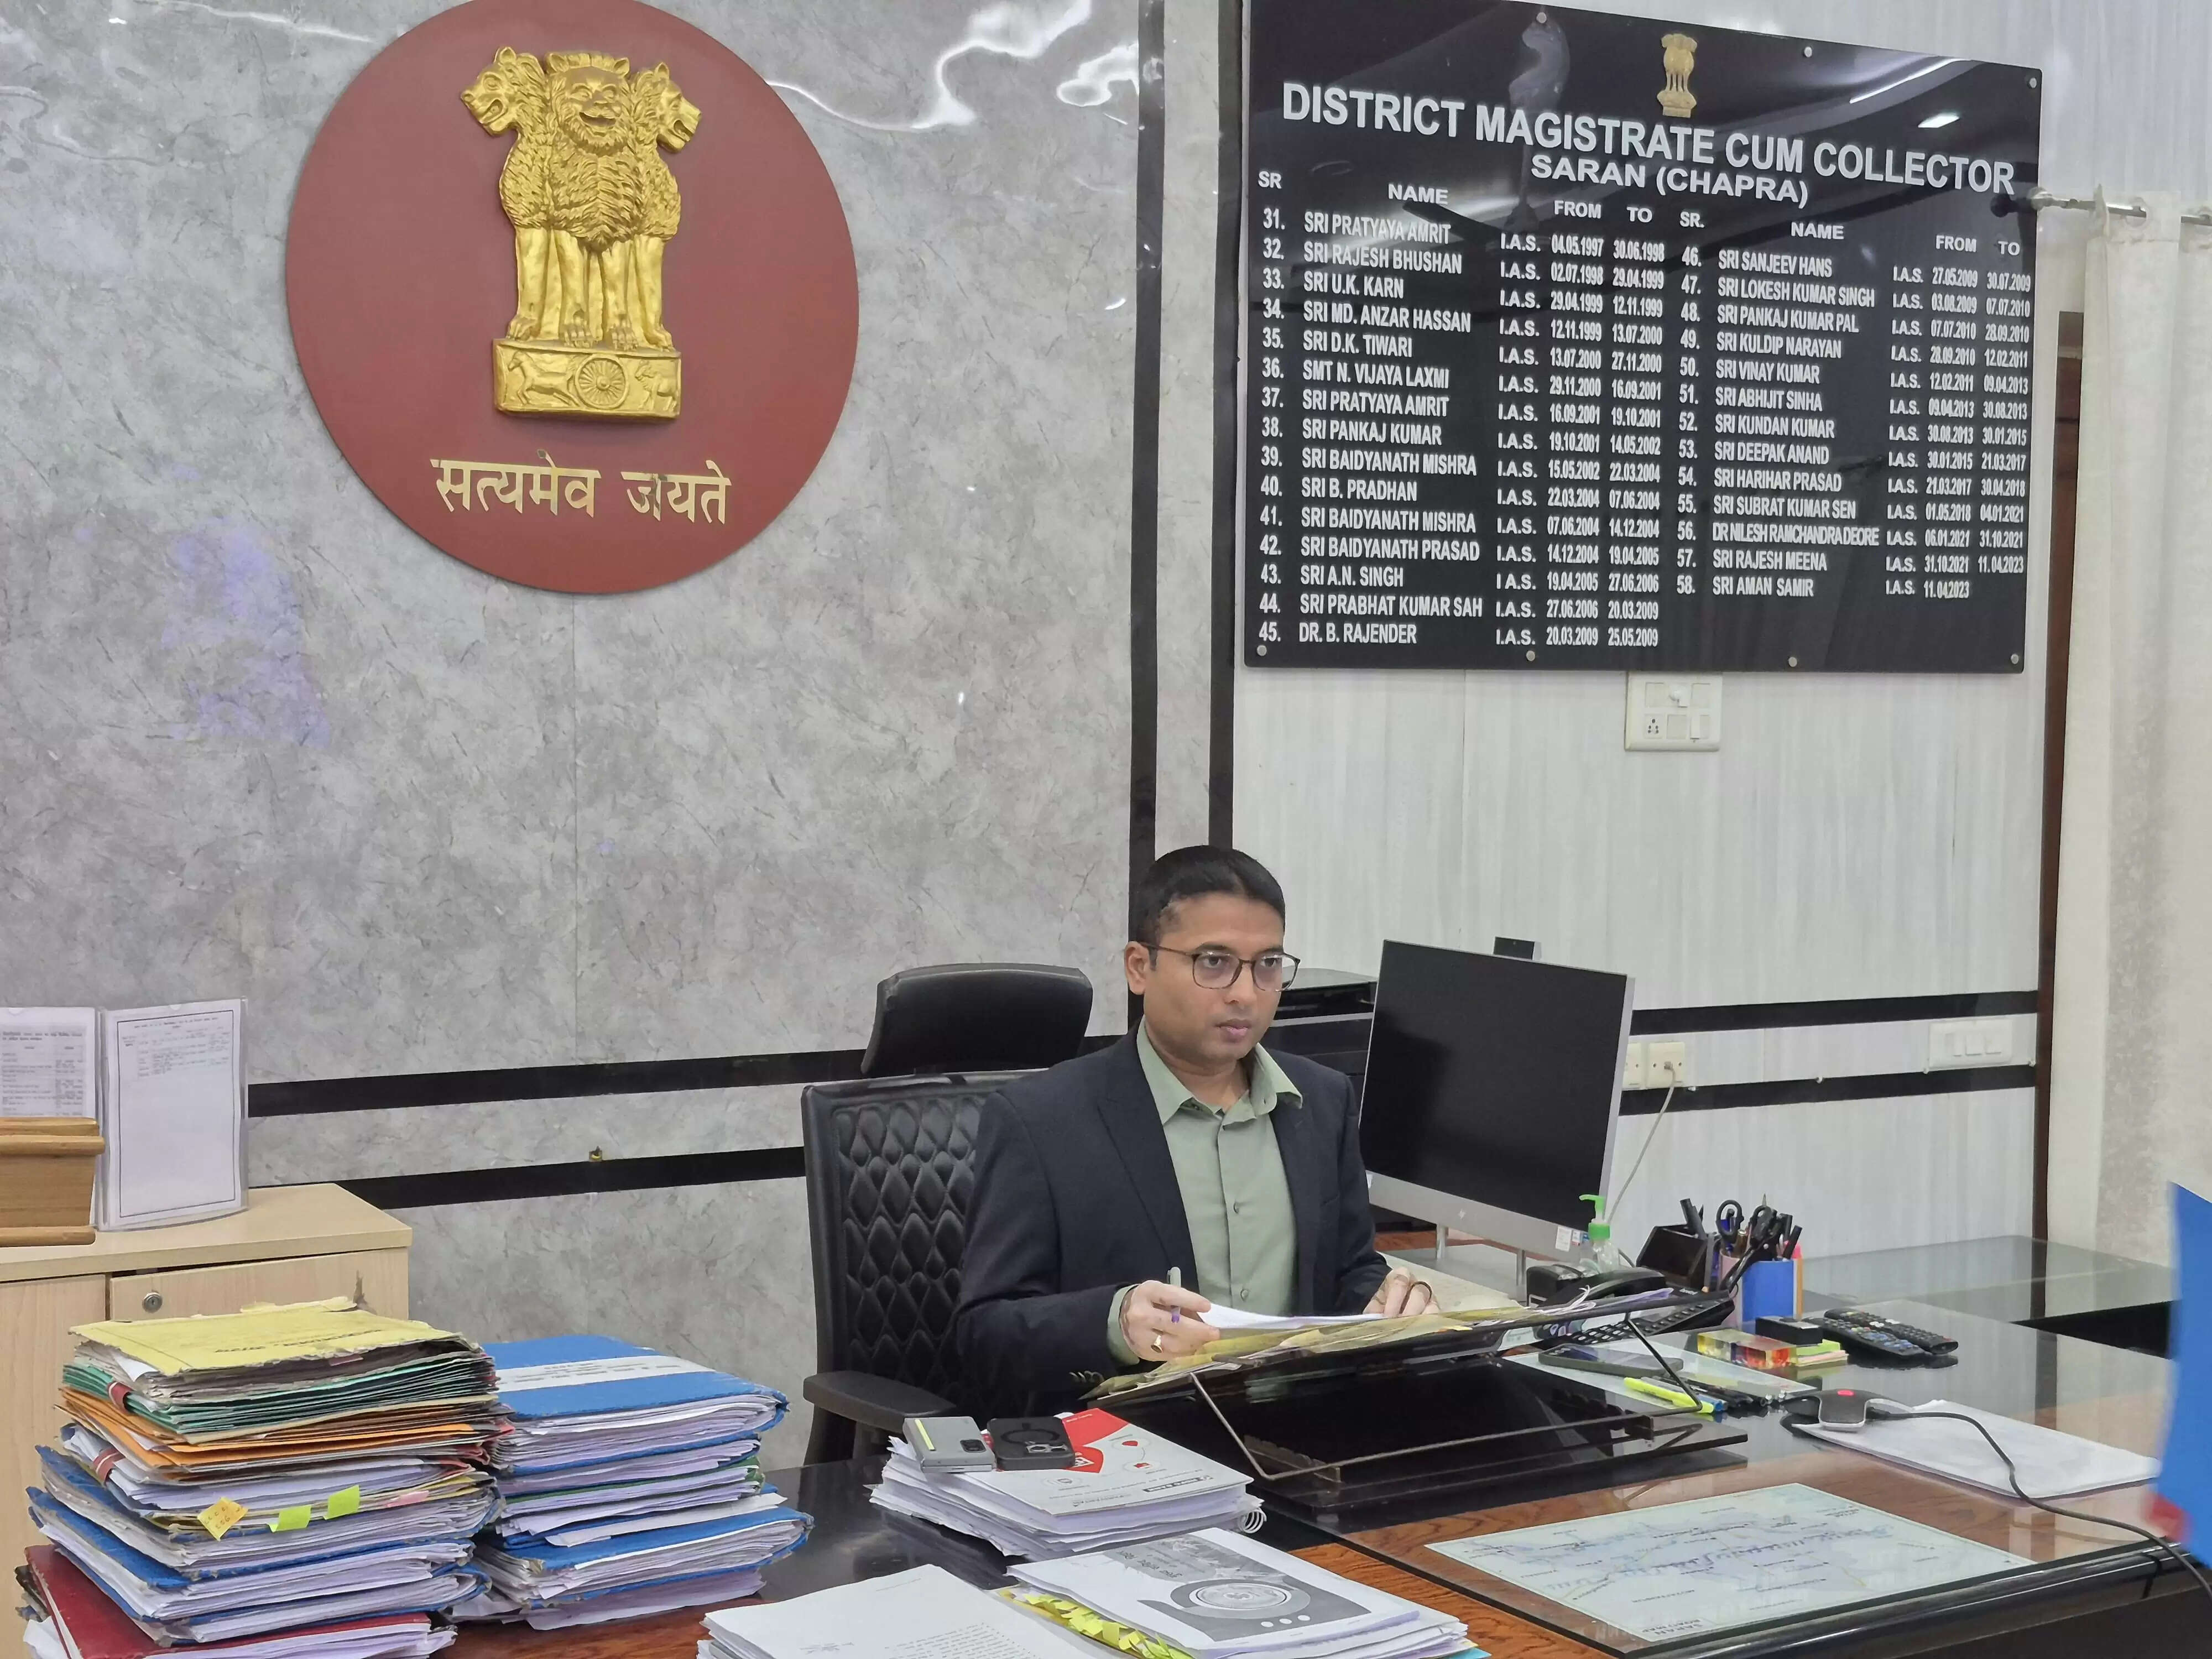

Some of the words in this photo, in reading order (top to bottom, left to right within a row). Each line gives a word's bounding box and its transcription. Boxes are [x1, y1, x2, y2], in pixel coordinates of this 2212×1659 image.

[1284, 82, 1464, 137] DISTRICT
[1476, 105, 1715, 164] MAGISTRATE
[1726, 133, 1803, 173] CUM
[1813, 142, 2015, 195] COLLECTOR
[1258, 170, 1282, 189] SR
[1388, 183, 1448, 205] NAME
[1531, 154, 1646, 188] SARAN
[1656, 167, 1809, 209] (CHAPRA)
[1553, 199, 1602, 219] FROM
[1626, 206, 1653, 223] TO
[1679, 211, 1705, 228] SR.
[1262, 206, 1285, 230] 31.
[1303, 210, 1329, 234] SRI
[1332, 213, 1405, 242] PRATYAYA
[1406, 217, 1452, 244] AMRIT
[1500, 232, 1541, 252] I.A.S.
[1613, 238, 1665, 262] 30.06.1998
[1791, 222, 1844, 240] NAME
[1936, 235, 1978, 253] FROM
[1262, 236, 1284, 260] 32.
[1303, 239, 1332, 263] SRI
[1332, 243, 1389, 268] RAJESH
[1392, 248, 1462, 274] BHUSHAN
[1681, 245, 1702, 267] 46.
[1718, 248, 1739, 269] SRI
[1740, 250, 1798, 275] SANJEEV
[1798, 255, 1833, 278] HANS
[1997, 240, 2021, 257] TO
[1262, 267, 1285, 289] 33.
[1303, 269, 1329, 293] SRI
[1331, 272, 1360, 295] U.K.
[1363, 274, 1404, 299] KARN
[1680, 273, 1702, 295] 47.
[1717, 275, 1739, 298] SRI
[1740, 278, 1790, 301] LOKESH
[1792, 281, 1837, 305] KUMAR
[1838, 285, 1875, 307] SINGH
[1985, 296, 2031, 317] 07.07.2010
[1262, 296, 1285, 319] 34.
[1303, 299, 1328, 322] SRI
[1331, 301, 1358, 325] MD.
[1359, 304, 1410, 328] ANZAR
[1412, 307, 1472, 333] HASSAN
[1680, 301, 1700, 322] 48.
[1717, 303, 1738, 325] SRI
[1739, 304, 1788, 328] PANKAJ
[1790, 309, 1834, 331] KUMAR
[1835, 312, 1859, 333] PAL
[1262, 326, 1284, 349] 35.
[1302, 328, 1328, 352] SRI
[1331, 331, 1360, 354] D.K.
[1361, 333, 1412, 358] TIWARI
[1679, 327, 1700, 349] 49.
[1715, 330, 1737, 352] SRI
[1739, 331, 1784, 355] KULDIP
[1785, 335, 1841, 359] NARAYAN
[1261, 356, 1284, 379] 36.
[1302, 358, 1333, 381] SMT
[1336, 361, 1352, 383] N.
[1354, 362, 1403, 386] VIJAYA
[1405, 364, 1449, 389] LAXMI
[1679, 356, 1699, 377] 50.
[1715, 358, 1737, 379] SRI
[1738, 359, 1775, 382] VINAY
[1776, 362, 1820, 384] KUMAR
[1261, 385, 1284, 408] 37.
[1302, 388, 1327, 410] SRI
[1329, 390, 1403, 415] PRATYAYA
[1404, 393, 1450, 417] AMRIT
[1678, 382, 1699, 405] 51.
[1714, 385, 1736, 406] SRI
[1736, 387, 1785, 410] ABHIJIT
[1785, 389, 1823, 412] SINHA
[1261, 415, 1283, 437] 38.
[1302, 417, 1327, 440] SRI
[1329, 419, 1387, 443] PANKAJ
[1389, 421, 1442, 446] KUMAR
[1678, 410, 1698, 431] 52.
[1714, 412, 1736, 434] SRI
[1737, 414, 1789, 436] KUNDAN
[1791, 416, 1835, 439] KUMAR
[1260, 445, 1283, 467] 39.
[1301, 446, 1327, 468] SRI
[1329, 447, 1420, 473] BAIDYANATH
[1422, 452, 1477, 476] MISHRA
[1678, 438, 1698, 459] 53.
[1714, 440, 1735, 461] SRI
[1736, 441, 1786, 463] DEEPAK
[1786, 443, 1829, 465] ANAND
[430, 449, 602, 518] सत्यमेव
[620, 460, 732, 524] जयते
[1260, 474, 1282, 497] 40.
[1301, 476, 1326, 498] SRI
[1328, 477, 1343, 499] B.
[1346, 478, 1417, 502] PRADHAN
[1496, 487, 1537, 507] I.A.S.
[1677, 465, 1697, 487] 54.
[1713, 466, 1734, 488] SRI
[1736, 468, 1791, 490] HARIHAR
[1792, 471, 1842, 492] PRASAD
[1259, 504, 1282, 526] 41.
[1301, 505, 1326, 528] SRI
[1328, 507, 1419, 531] BAIDYANATH
[1422, 510, 1476, 533] MISHRA
[1677, 493, 1697, 514] 55.
[1713, 494, 1734, 515] SRI
[1735, 495, 1785, 517] SUBRAT
[1786, 497, 1830, 518] KUMAR
[1831, 499, 1856, 519] SEN
[1259, 533, 1282, 555] 42.
[1300, 535, 1326, 557] SRI
[1328, 536, 1418, 560] BAIDYANATH
[1421, 539, 1480, 561] PRASAD
[1676, 519, 1696, 541] 56.
[1712, 521, 1729, 542] DR
[1729, 521, 1768, 542] NILESH
[1842, 525, 1880, 546] DEORE
[1676, 547, 1697, 567] 57.
[1712, 547, 1733, 568] SRI
[1735, 548, 1783, 570] RAJESH
[1785, 550, 1828, 571] MEENA
[1923, 554, 1969, 573] 31.10.2021
[1260, 562, 1281, 585] 43.
[1300, 564, 1324, 585] SRI
[1326, 564, 1356, 586] A.N.
[1359, 565, 1404, 587] SINGH
[1608, 571, 1659, 593] 27.06.2006
[1676, 573, 1695, 594] 58.
[1712, 575, 1734, 595] SRI
[1735, 576, 1772, 596] AMAN
[1776, 577, 1814, 597] SAMIR
[1259, 592, 1281, 613] 44.
[1299, 592, 1324, 614] SRI
[1327, 593, 1396, 615] PRABHAT
[1398, 595, 1451, 617] KUMAR
[1452, 596, 1483, 617] SAH
[1546, 598, 1598, 619] 27.06.2006
[1607, 599, 1659, 620] 20.03.2009
[1258, 620, 1281, 642] 45.
[1298, 621, 1323, 643] DR.
[1326, 622, 1340, 643] B.
[1343, 622, 1417, 644] RAJENDER
[1495, 628, 1535, 645] I.A.S.
[1545, 625, 1598, 646] 20.03.2009
[1607, 626, 1658, 647] 25.05.2009
